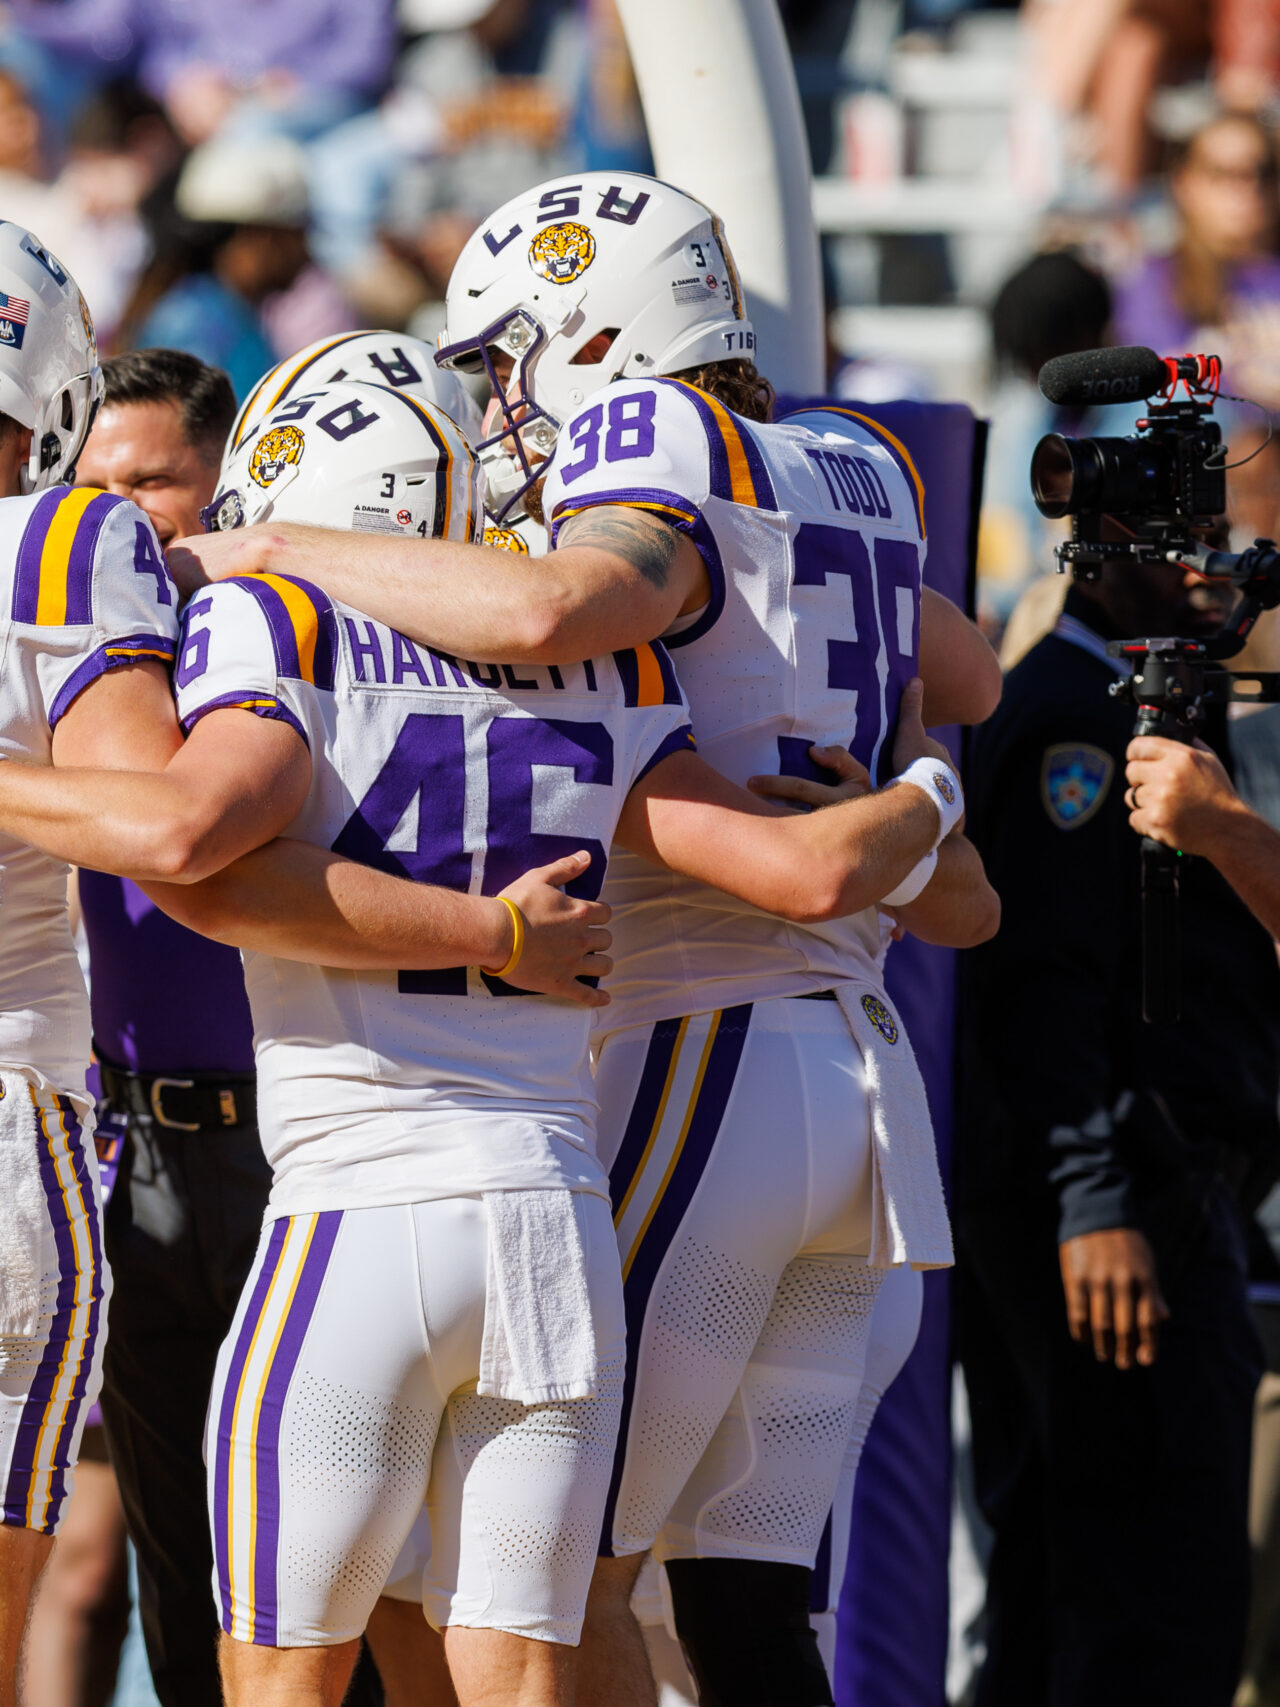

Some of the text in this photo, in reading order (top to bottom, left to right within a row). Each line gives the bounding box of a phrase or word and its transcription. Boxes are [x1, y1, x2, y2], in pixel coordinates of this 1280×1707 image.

[482, 184, 651, 256] LSU
[690, 243, 706, 267] 3
[724, 331, 757, 351] TIG
[560, 390, 656, 486] 38
[380, 472, 395, 498] 3
[803, 448, 893, 519] TODD
[133, 520, 173, 607] 4
[176, 597, 213, 691] 6
[331, 713, 614, 997] 46
